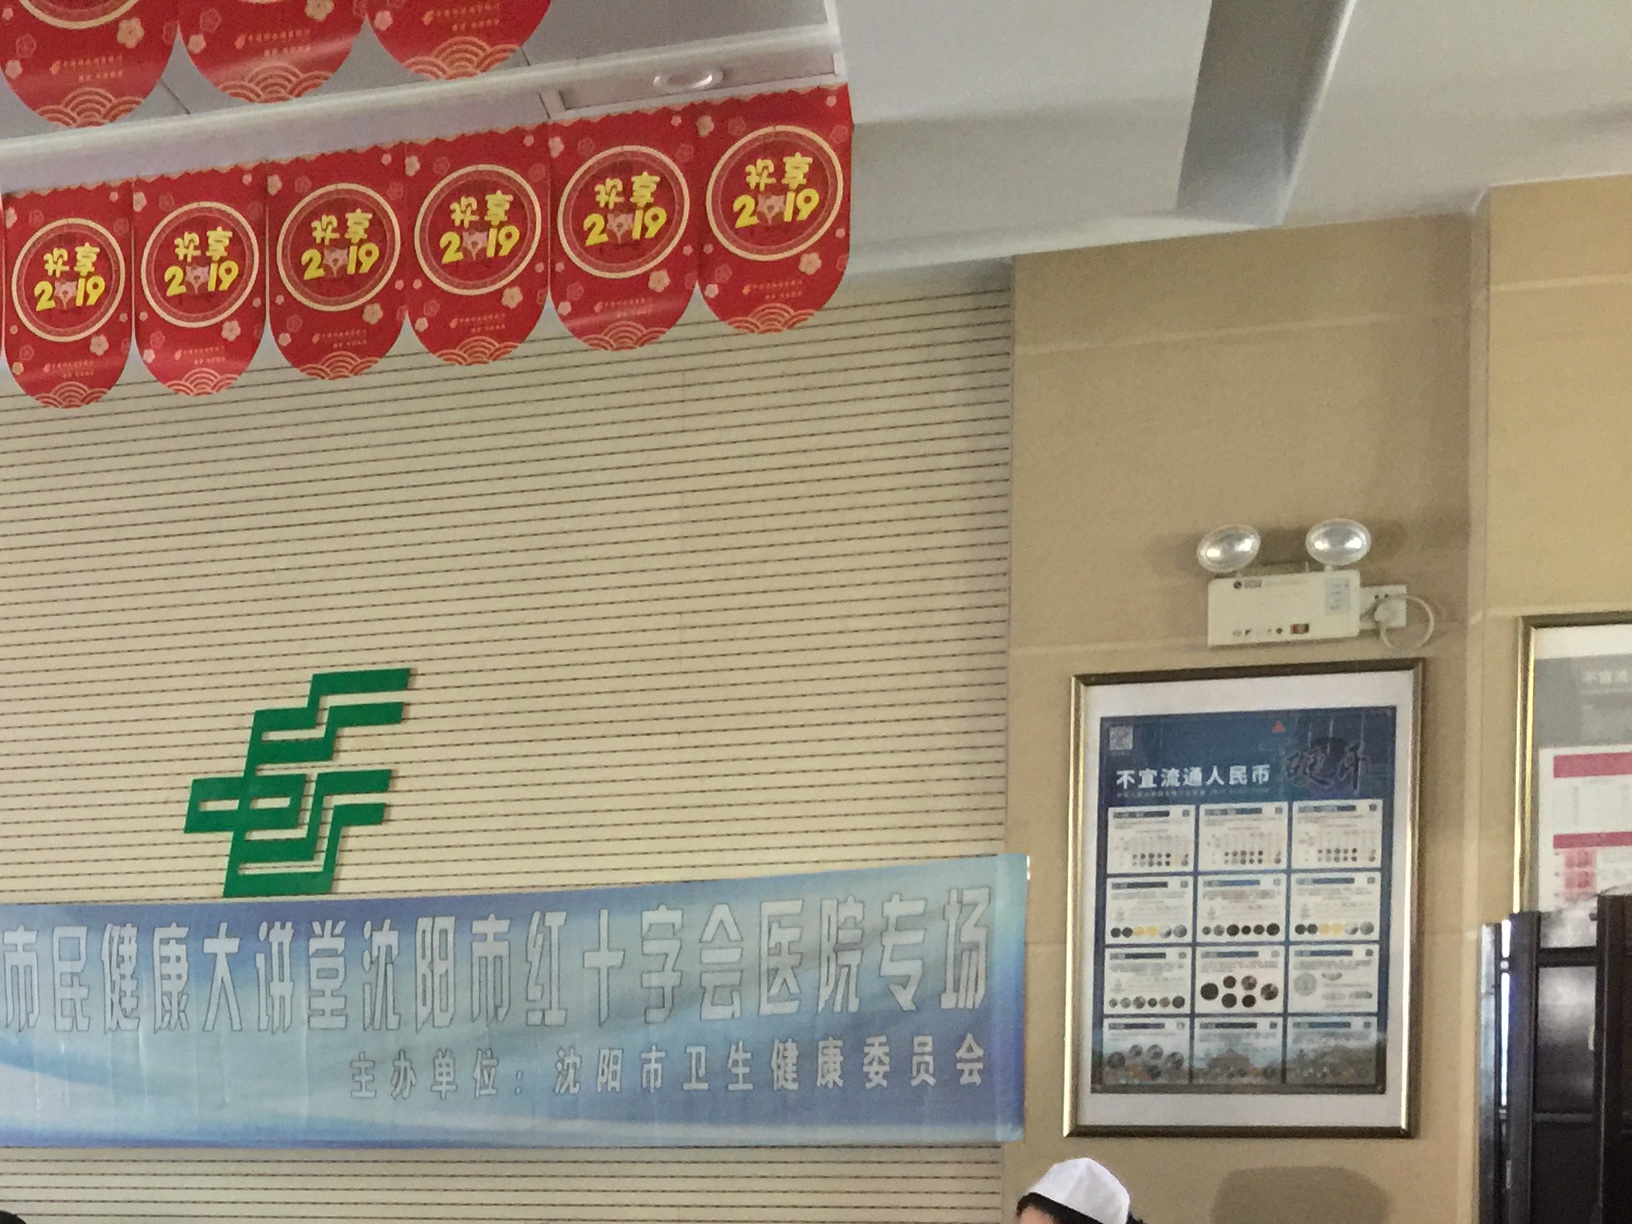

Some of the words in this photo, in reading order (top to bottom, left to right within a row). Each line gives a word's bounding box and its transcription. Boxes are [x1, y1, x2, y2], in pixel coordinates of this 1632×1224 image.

[1115, 764, 1270, 790] 不宜流通人民币
